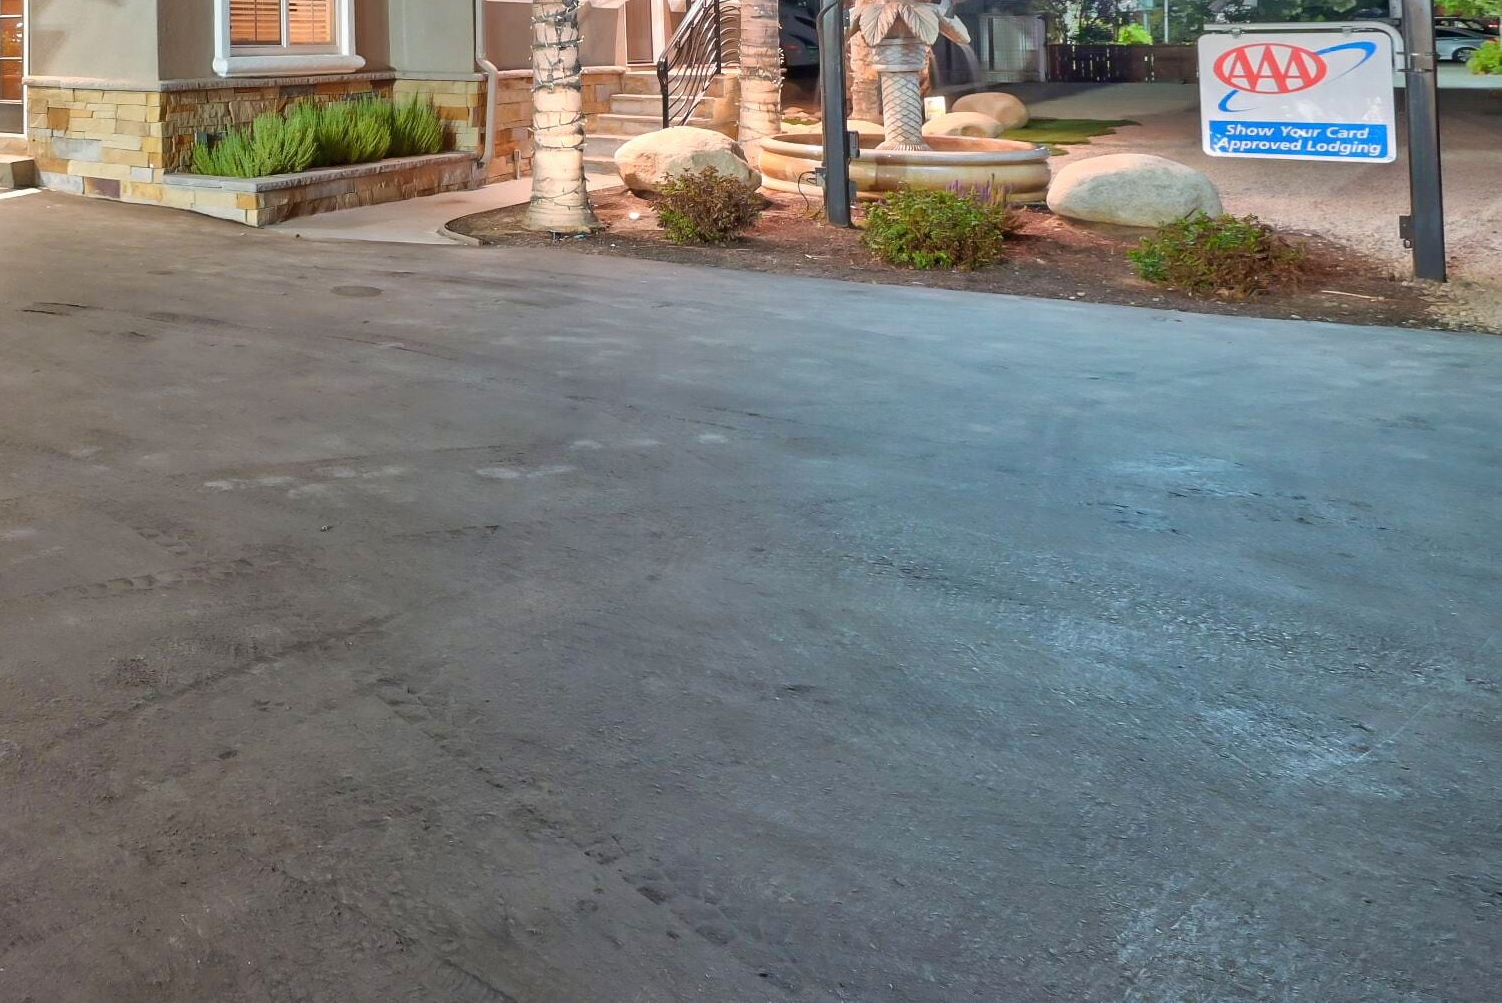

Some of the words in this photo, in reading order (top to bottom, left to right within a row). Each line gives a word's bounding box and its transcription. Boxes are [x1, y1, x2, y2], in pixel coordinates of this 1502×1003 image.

[1223, 43, 1317, 94] AAA
[1225, 124, 1275, 136] Show
[1280, 125, 1321, 138] Your
[1326, 126, 1370, 139] Card
[1217, 136, 1301, 151] Approved
[1306, 139, 1381, 156] Lodging
